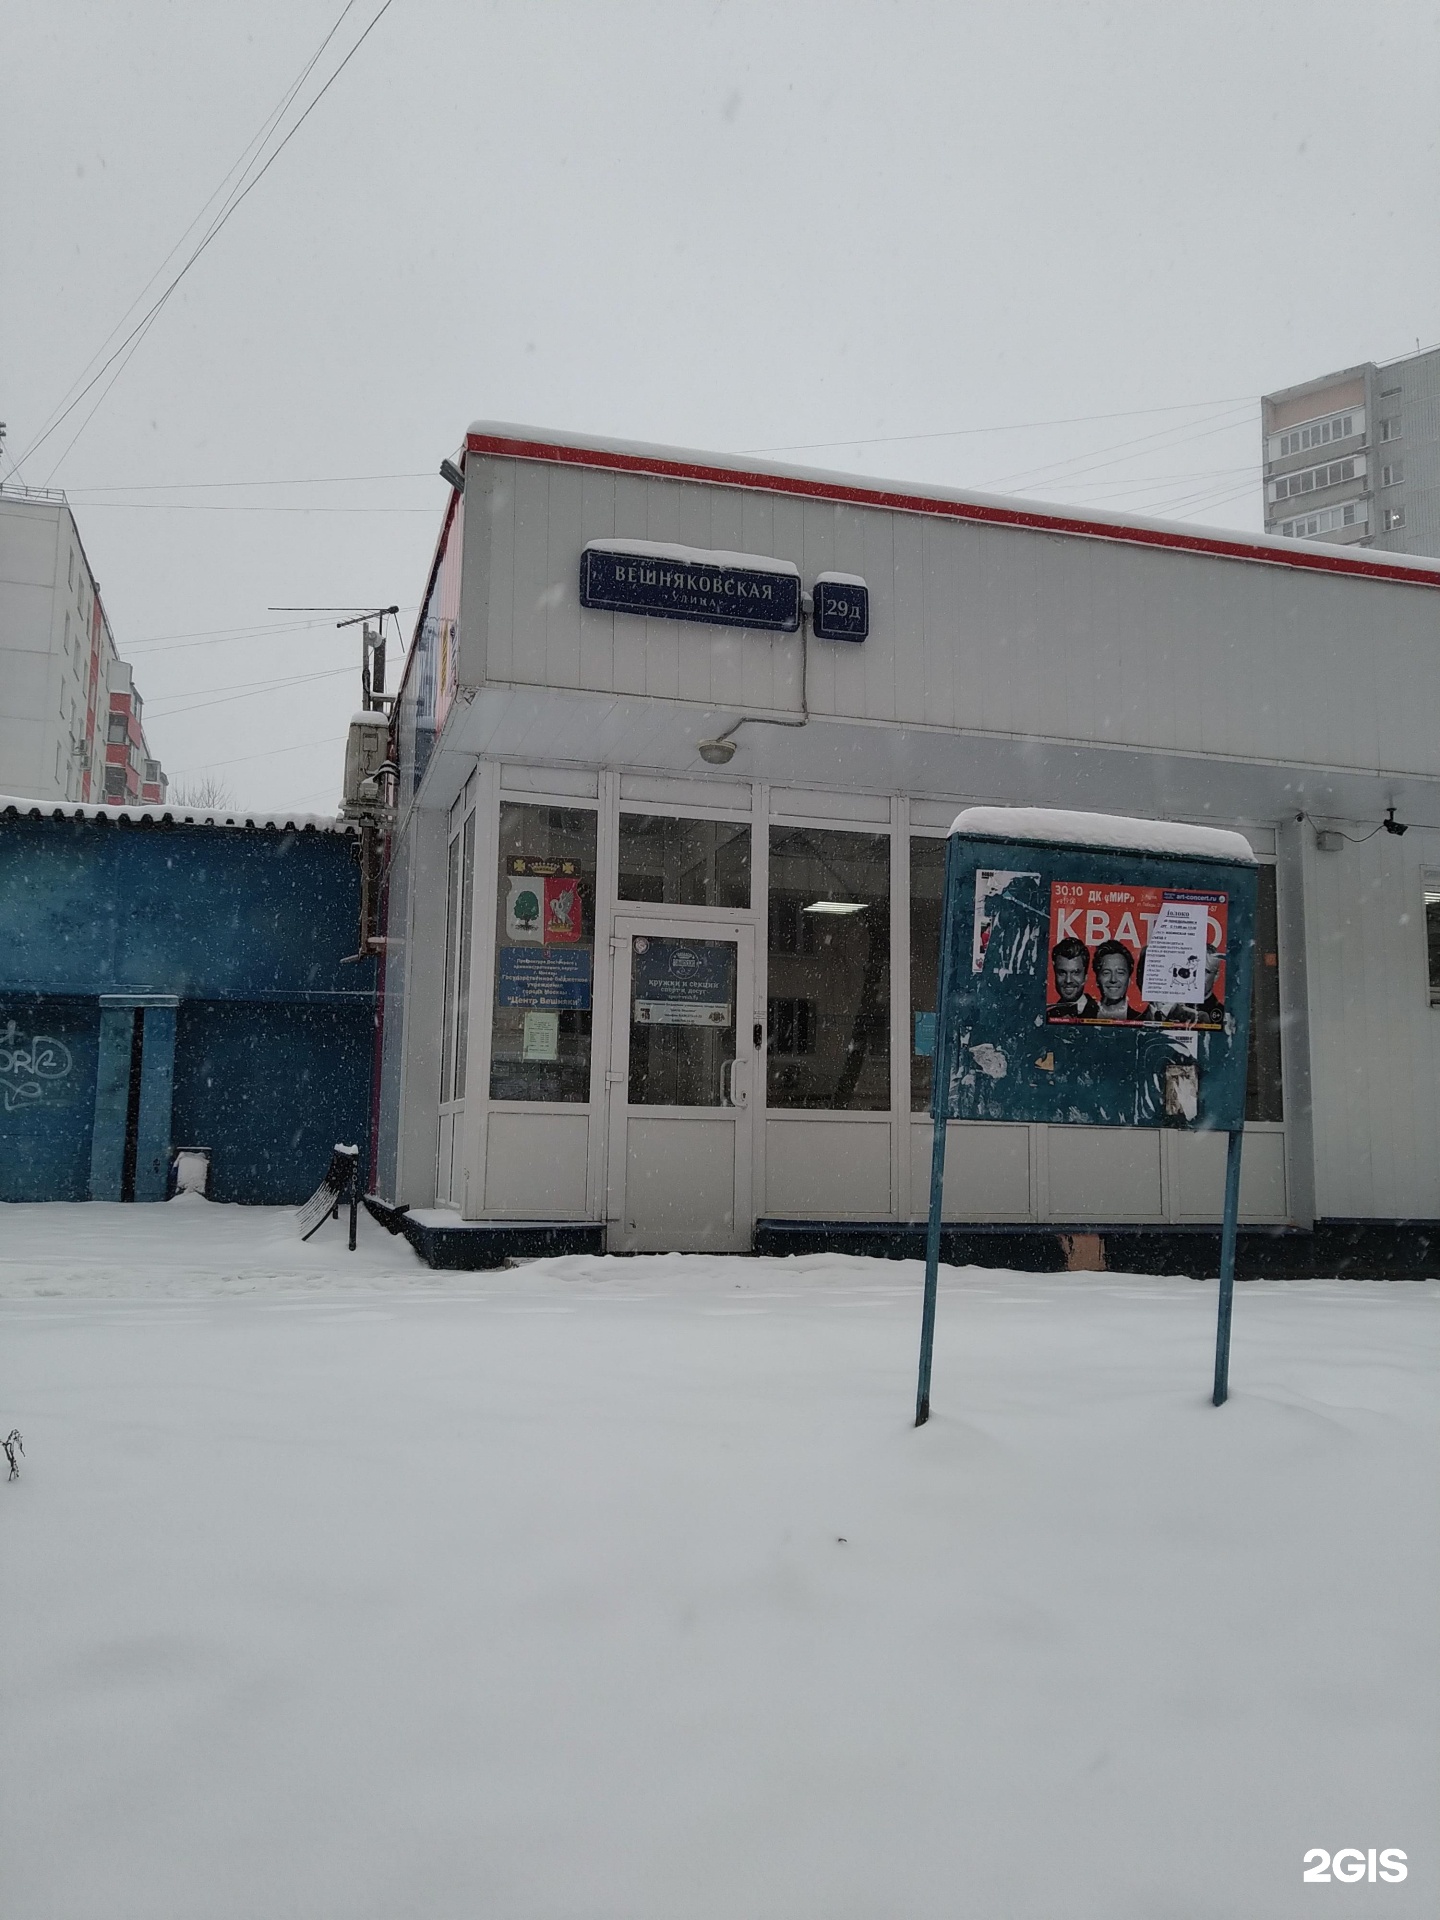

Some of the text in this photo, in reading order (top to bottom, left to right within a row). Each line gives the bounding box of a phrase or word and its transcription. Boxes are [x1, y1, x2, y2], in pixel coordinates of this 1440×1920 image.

[615, 565, 772, 600] ВЕШНЯКОВСКАЯ
[672, 593, 716, 606] УЛИЦА
[1055, 885, 1083, 896] 30.10
[1088, 890, 1102, 903] ДК
[1104, 891, 1135, 904] «МИР»
[1176, 894, 1217, 902] art-concert.ru
